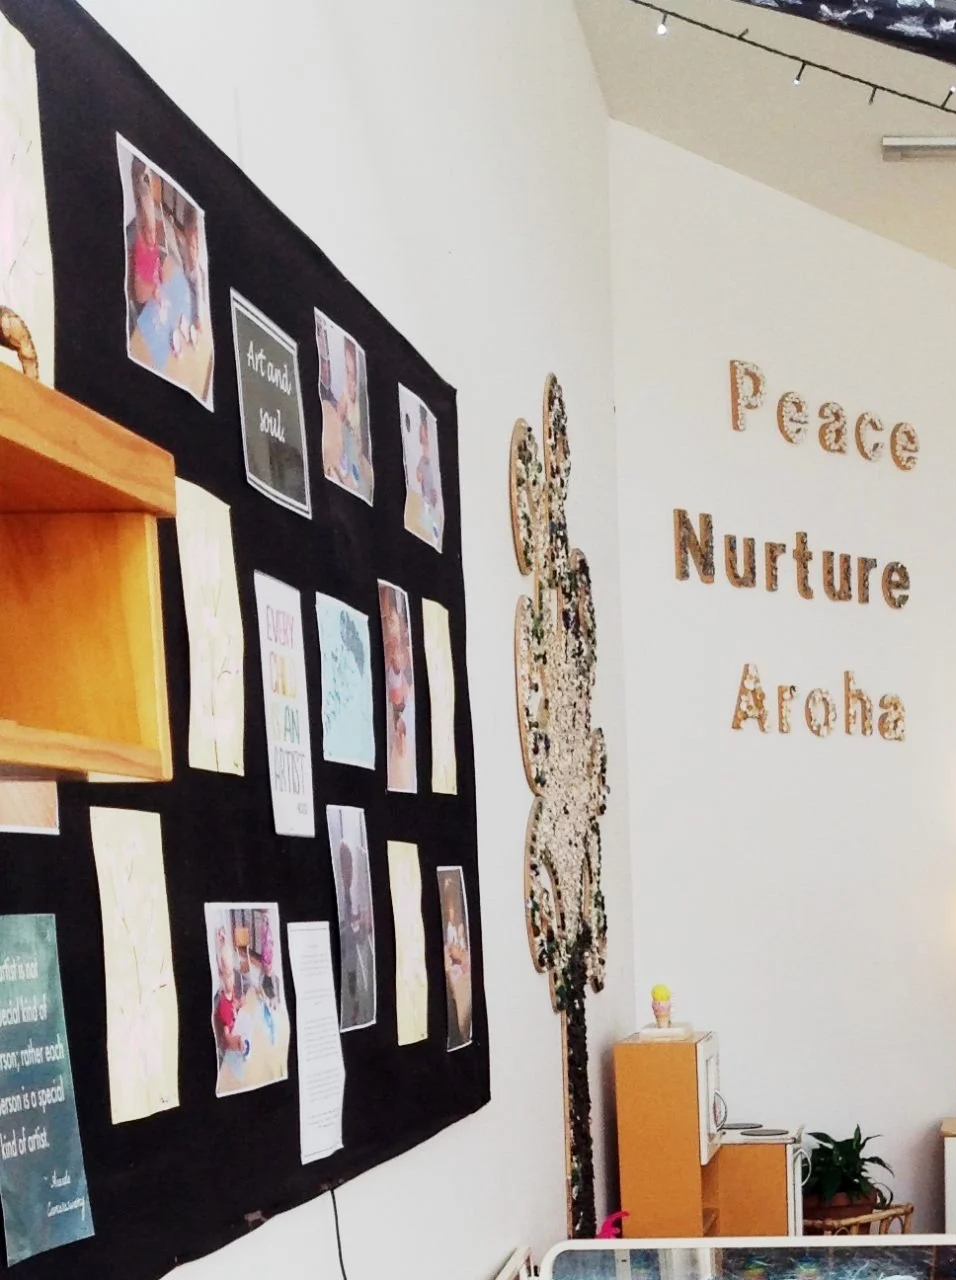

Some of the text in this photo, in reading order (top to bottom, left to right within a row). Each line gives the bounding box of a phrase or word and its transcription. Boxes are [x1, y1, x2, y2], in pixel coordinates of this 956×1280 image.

[246, 340, 292, 396] Art and
[729, 359, 919, 471] Peace
[673, 508, 910, 610] Nurture
[266, 604, 294, 649] EVERY
[284, 704, 301, 745] AN
[731, 662, 905, 742] Aroha
[274, 745, 305, 794] ARTIST
[20, 994, 38, 1022] kind
[39, 992, 47, 1021] of
[20, 1038, 43, 1067] rather
[45, 1032, 65, 1062] each
[21, 1085, 30, 1109] is
[31, 1091, 37, 1108] a
[38, 1075, 65, 1114] special
[18, 1126, 26, 1156] of
